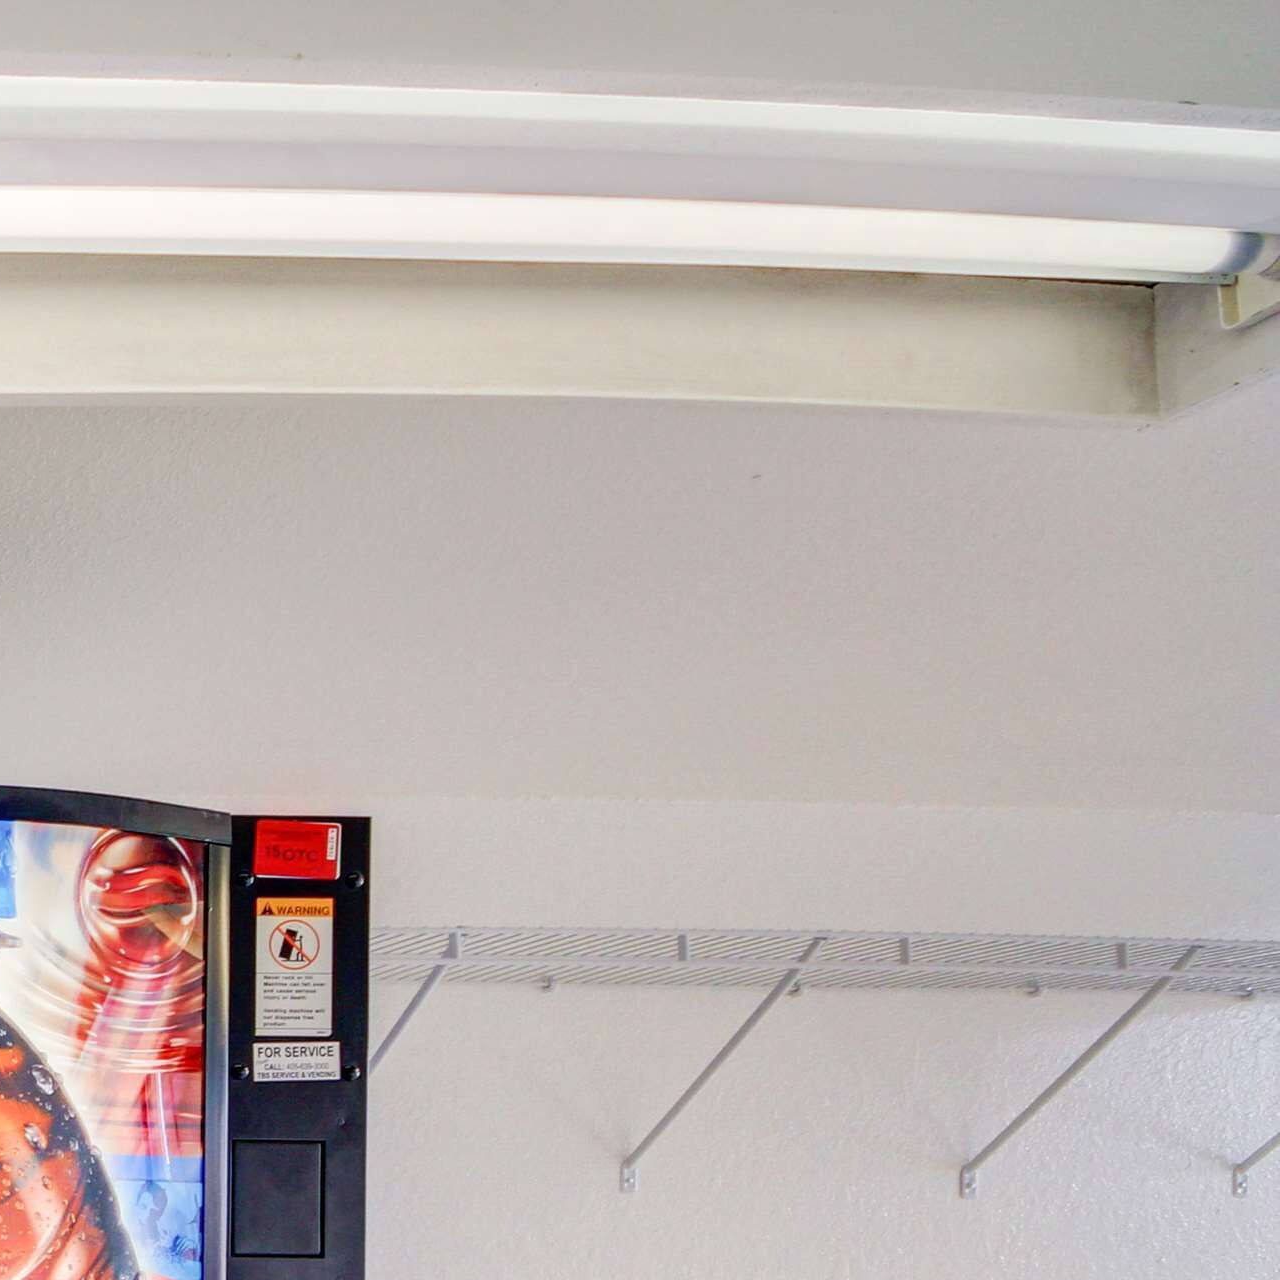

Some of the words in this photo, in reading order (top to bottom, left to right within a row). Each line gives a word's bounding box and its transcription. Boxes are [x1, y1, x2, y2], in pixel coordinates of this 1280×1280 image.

[276, 905, 330, 916] WARNING
[257, 1047, 281, 1058] FOR
[284, 1045, 334, 1058] SERVICE
